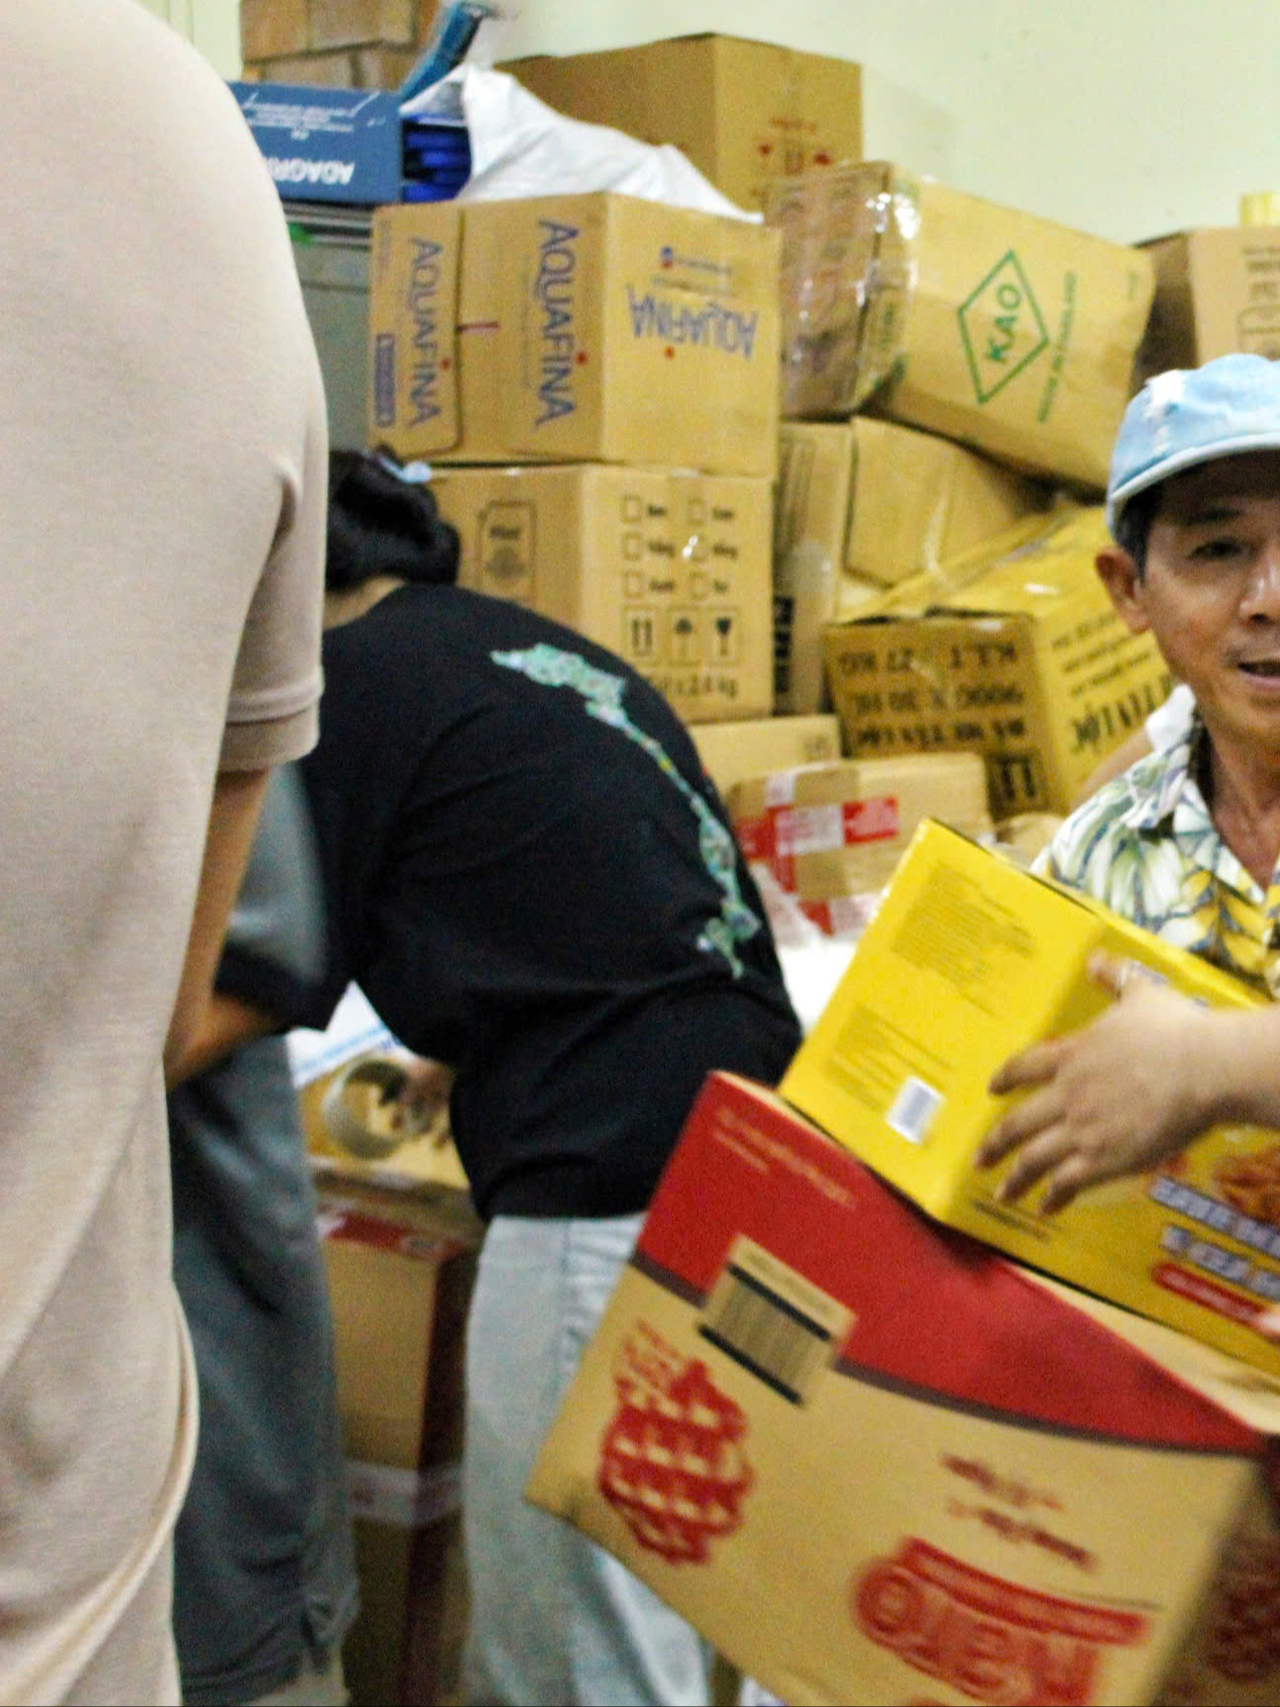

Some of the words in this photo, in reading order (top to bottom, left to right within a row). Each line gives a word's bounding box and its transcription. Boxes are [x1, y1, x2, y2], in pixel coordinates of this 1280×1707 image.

[408, 237, 447, 430] AQUAFINA
[534, 218, 585, 429] AQUAFINA
[628, 287, 757, 359] AQUAFINA
[985, 283, 1022, 365] KAO
